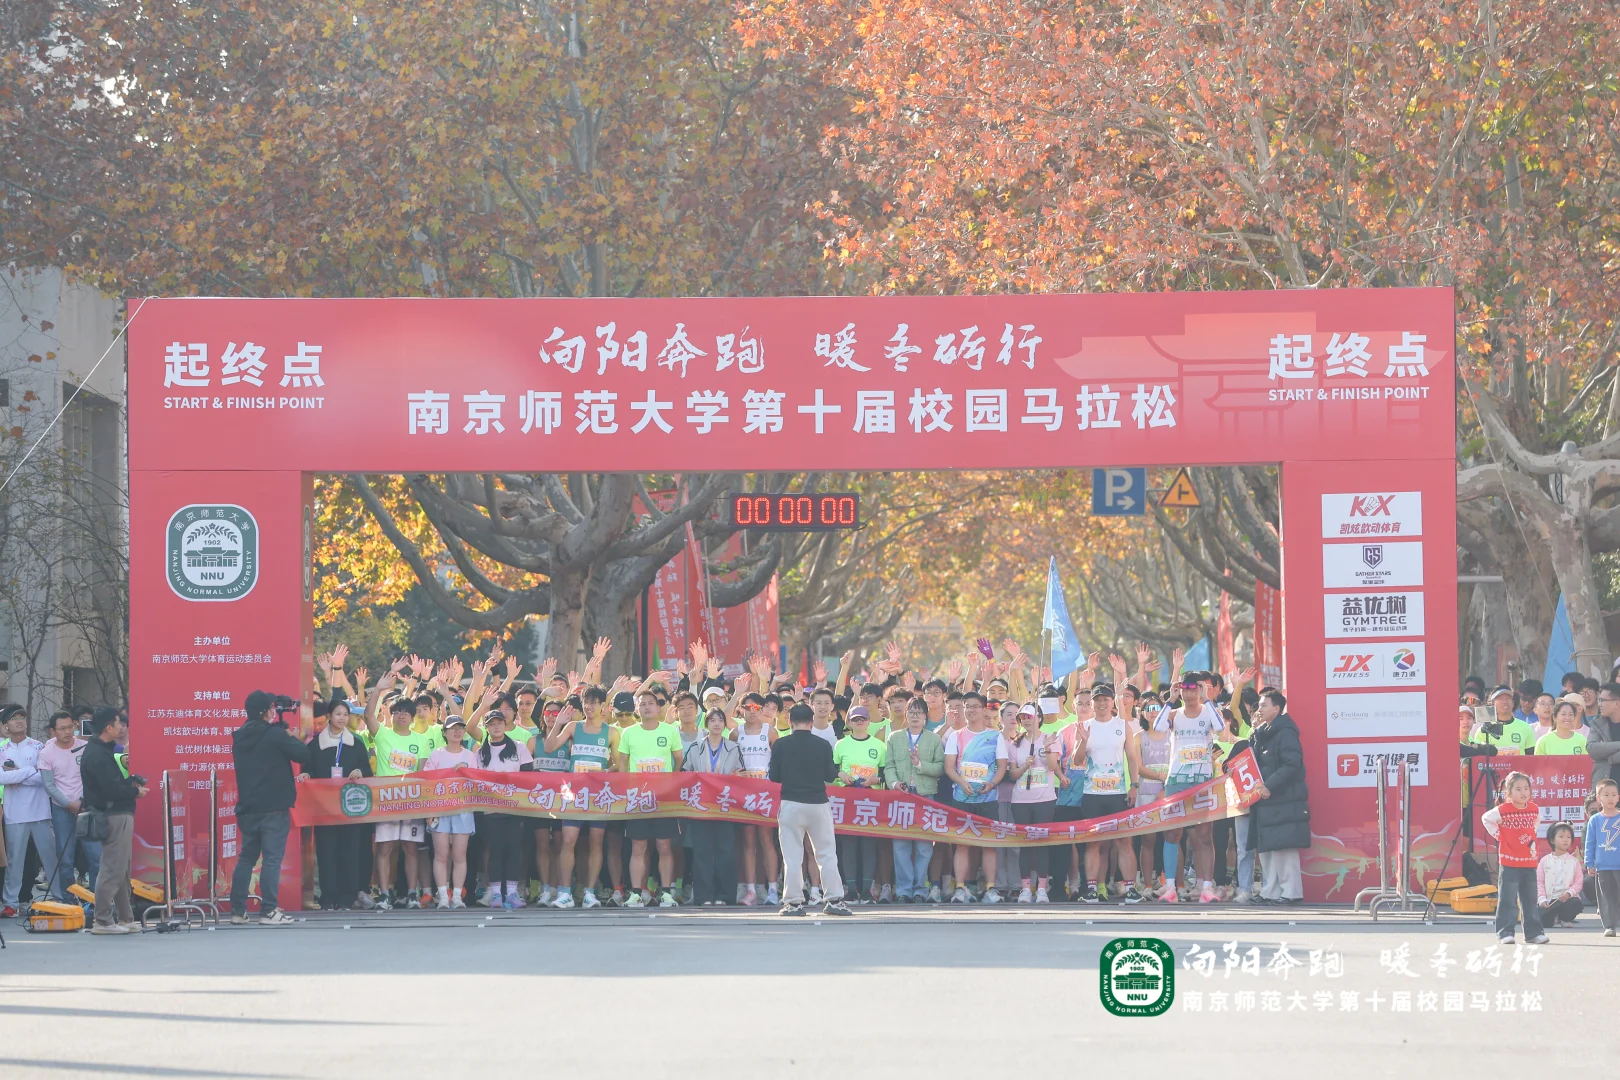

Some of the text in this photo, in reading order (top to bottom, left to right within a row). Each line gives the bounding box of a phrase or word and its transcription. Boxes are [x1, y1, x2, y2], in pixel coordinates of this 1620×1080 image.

[539, 321, 1043, 378] 向阳奔跑 暖冬砺行
[1268, 331, 1430, 380] 起终点
[163, 341, 325, 388] 起终点
[1268, 387, 1430, 401] START & FINISH POINT
[163, 397, 325, 409] START & FINISH POINT
[407, 384, 1177, 435] 南京师范大学第十届校园马拉松
[1104, 469, 1133, 507] P
[173, 509, 250, 532] 南京师范大学
[172, 550, 252, 595] NANJING NORMAL UNIVERSITY
[200, 572, 225, 580] NNU
[1343, 596, 1406, 615] 益优树
[1343, 616, 1407, 626] GYMTREE
[193, 636, 231, 646] 主办单位
[152, 653, 272, 664] 南京师范大学体育运动委员会
[193, 691, 231, 700] 支持单位
[147, 708, 249, 719] 江苏东迪体育文化发展有
[175, 744, 233, 754] 益优树体操运
[179, 763, 235, 772] 康力源体育科
[1239, 764, 1255, 791] 5
[380, 784, 421, 802] NNU
[435, 781, 518, 797] 南京师范大学
[379, 800, 421, 812] NANJING
[423, 799, 463, 809] NORMAL
[528, 779, 661, 816] 向阳奔跑
[680, 781, 773, 818] 暖冬砺
[412, 827, 417, 836] 8
